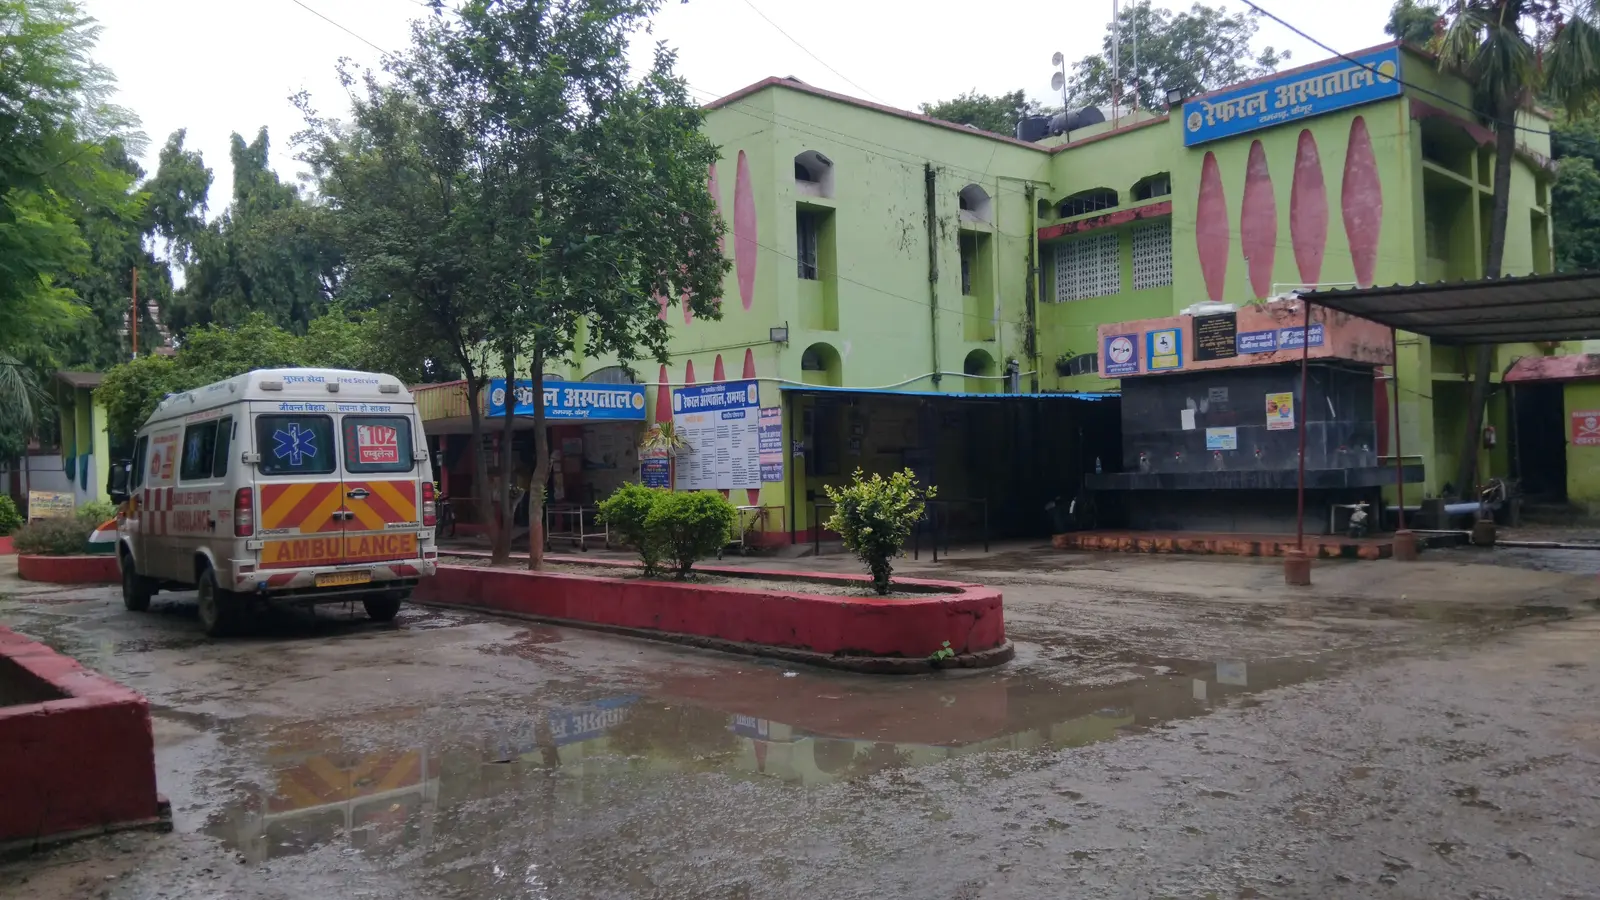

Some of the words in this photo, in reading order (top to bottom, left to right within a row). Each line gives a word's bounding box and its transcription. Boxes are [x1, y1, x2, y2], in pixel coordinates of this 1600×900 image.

[1200, 88, 1269, 126] रेफरल
[1274, 61, 1376, 109] अस्पताल
[306, 375, 325, 383] सेवा
[360, 404, 368, 412] हो
[563, 387, 632, 409] अस्पताल
[367, 425, 397, 445] 102
[277, 534, 411, 561] AMBULANCE
